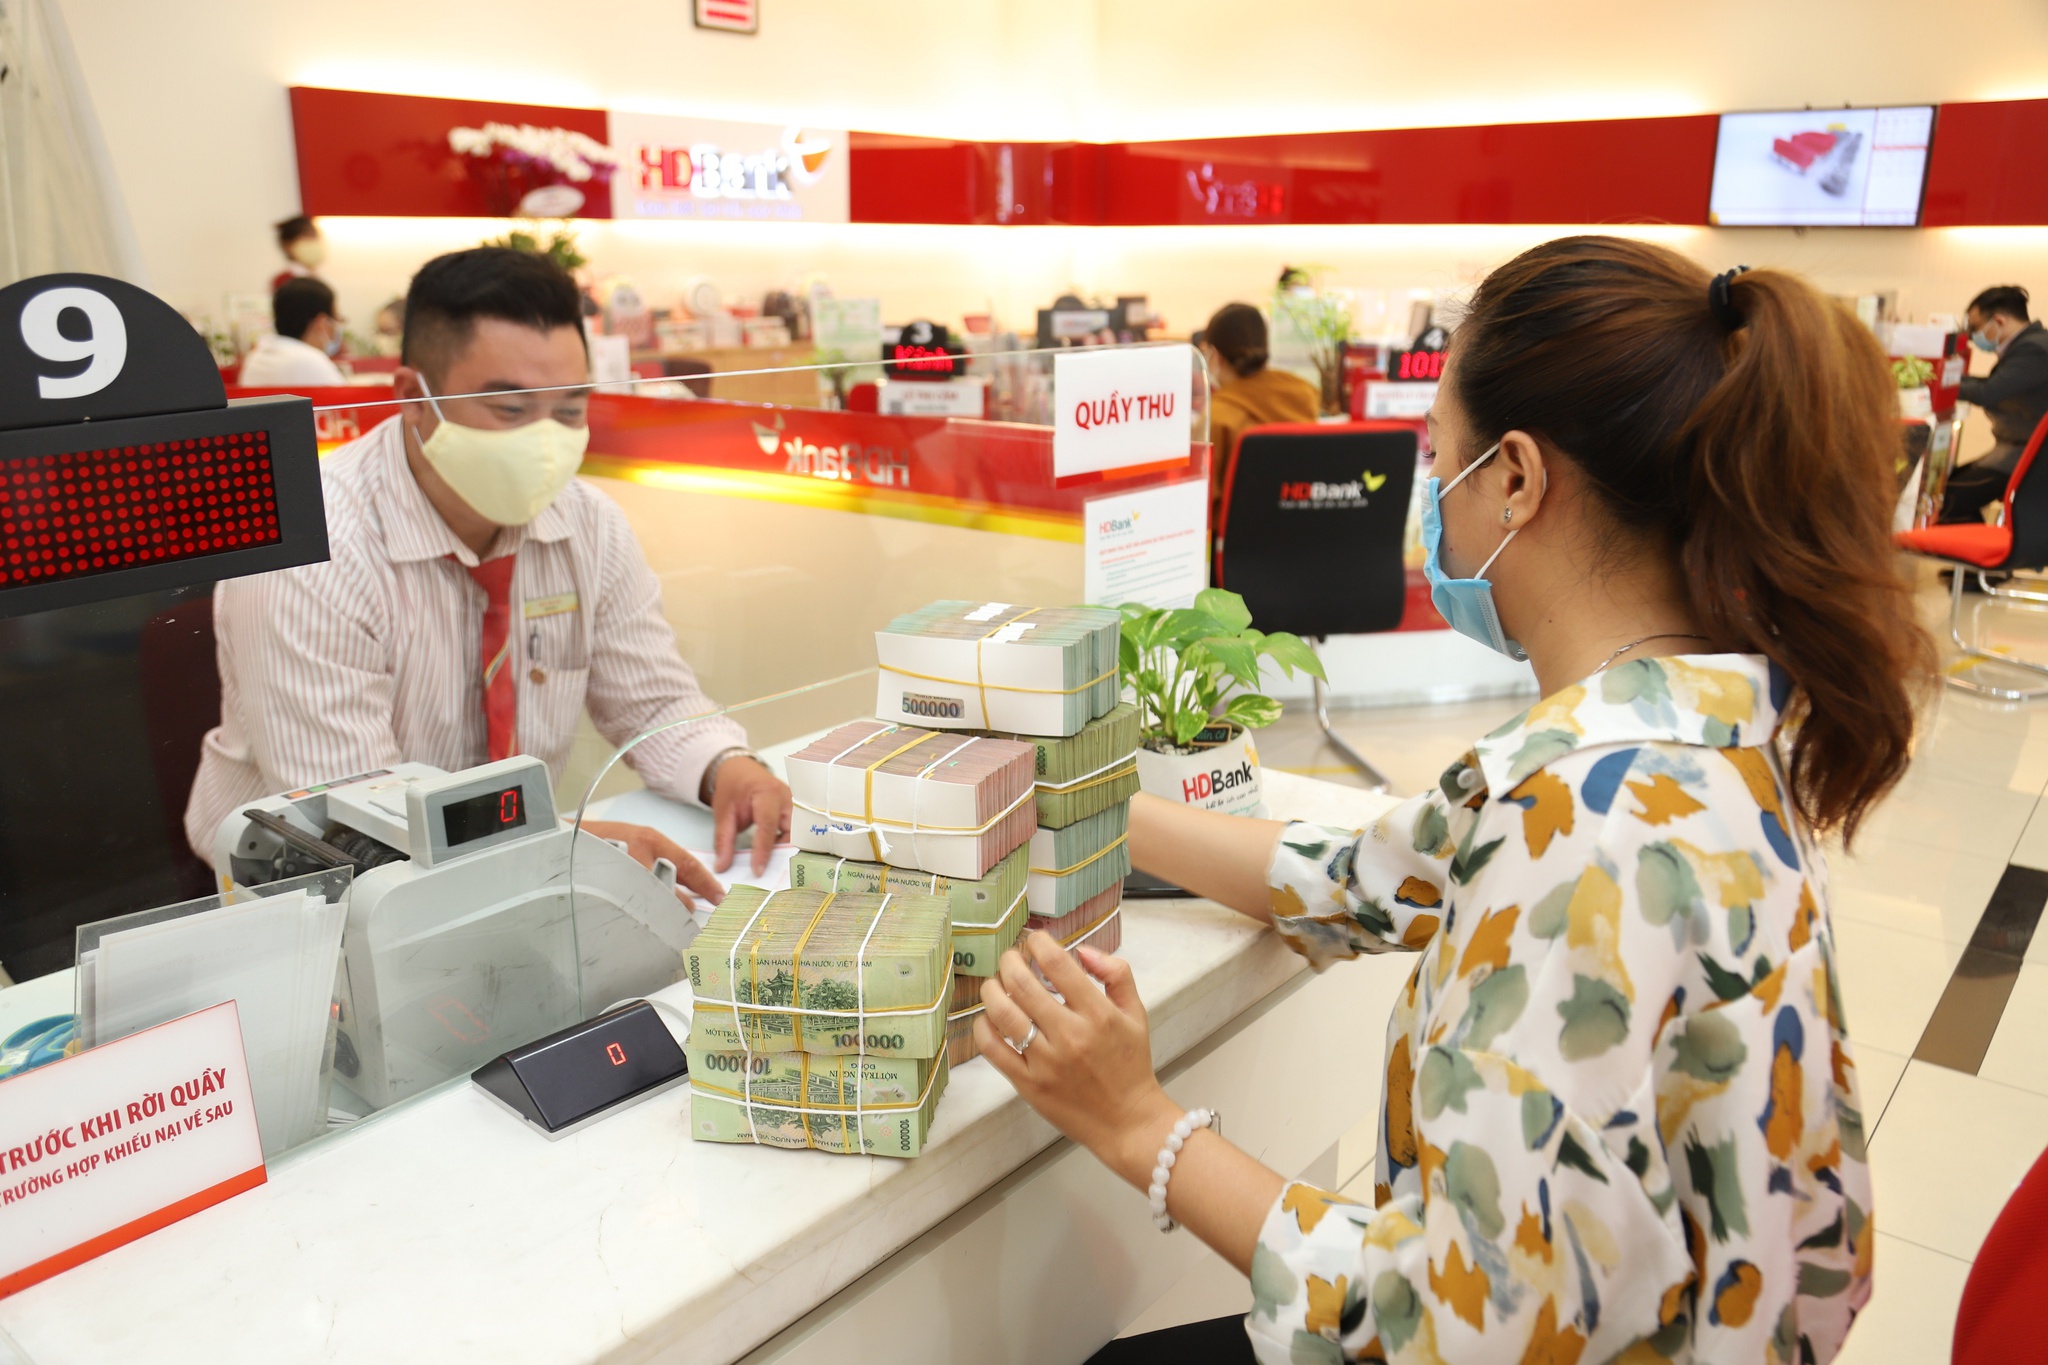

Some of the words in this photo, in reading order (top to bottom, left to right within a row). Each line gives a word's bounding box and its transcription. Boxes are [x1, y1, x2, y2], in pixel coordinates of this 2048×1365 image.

[20, 287, 127, 399] 9
[1075, 390, 1133, 430] QUẦY
[1137, 393, 1174, 420] THU
[1280, 480, 1364, 500] HDBank
[1099, 518, 1132, 534] HDBank
[1182, 761, 1253, 803] HDBank
[500, 790, 518, 823] 0
[866, 873, 881, 882] HÀN
[922, 880, 932, 889] VIỆ
[606, 1043, 627, 1066] 0
[0, 1127, 77, 1176] TRƯỚC
[81, 1110, 122, 1142] KHI
[127, 1092, 166, 1124] RỜI
[170, 1068, 227, 1106] QUẦY
[67, 1153, 101, 1178] HỢP
[104, 1132, 151, 1164] KHIẾU
[155, 1121, 182, 1142] NẠI
[184, 1108, 203, 1131] VỀ
[206, 1101, 234, 1123] SAU
